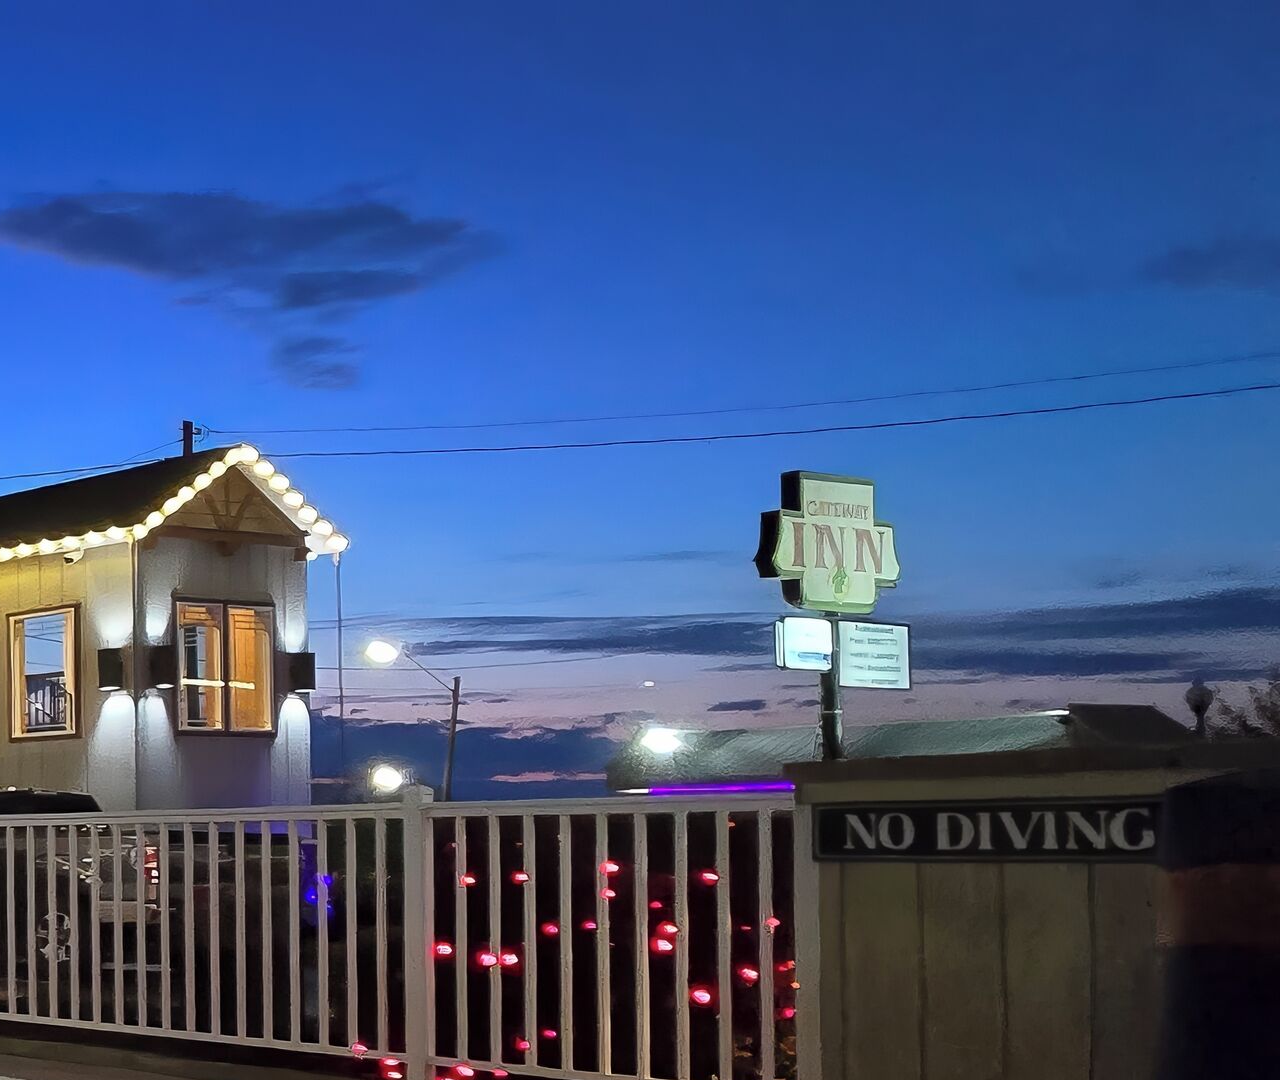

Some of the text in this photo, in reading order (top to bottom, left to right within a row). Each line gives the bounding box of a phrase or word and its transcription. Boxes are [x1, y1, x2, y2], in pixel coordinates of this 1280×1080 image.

[791, 522, 885, 574] INN
[843, 808, 1156, 851] NO DIVING
